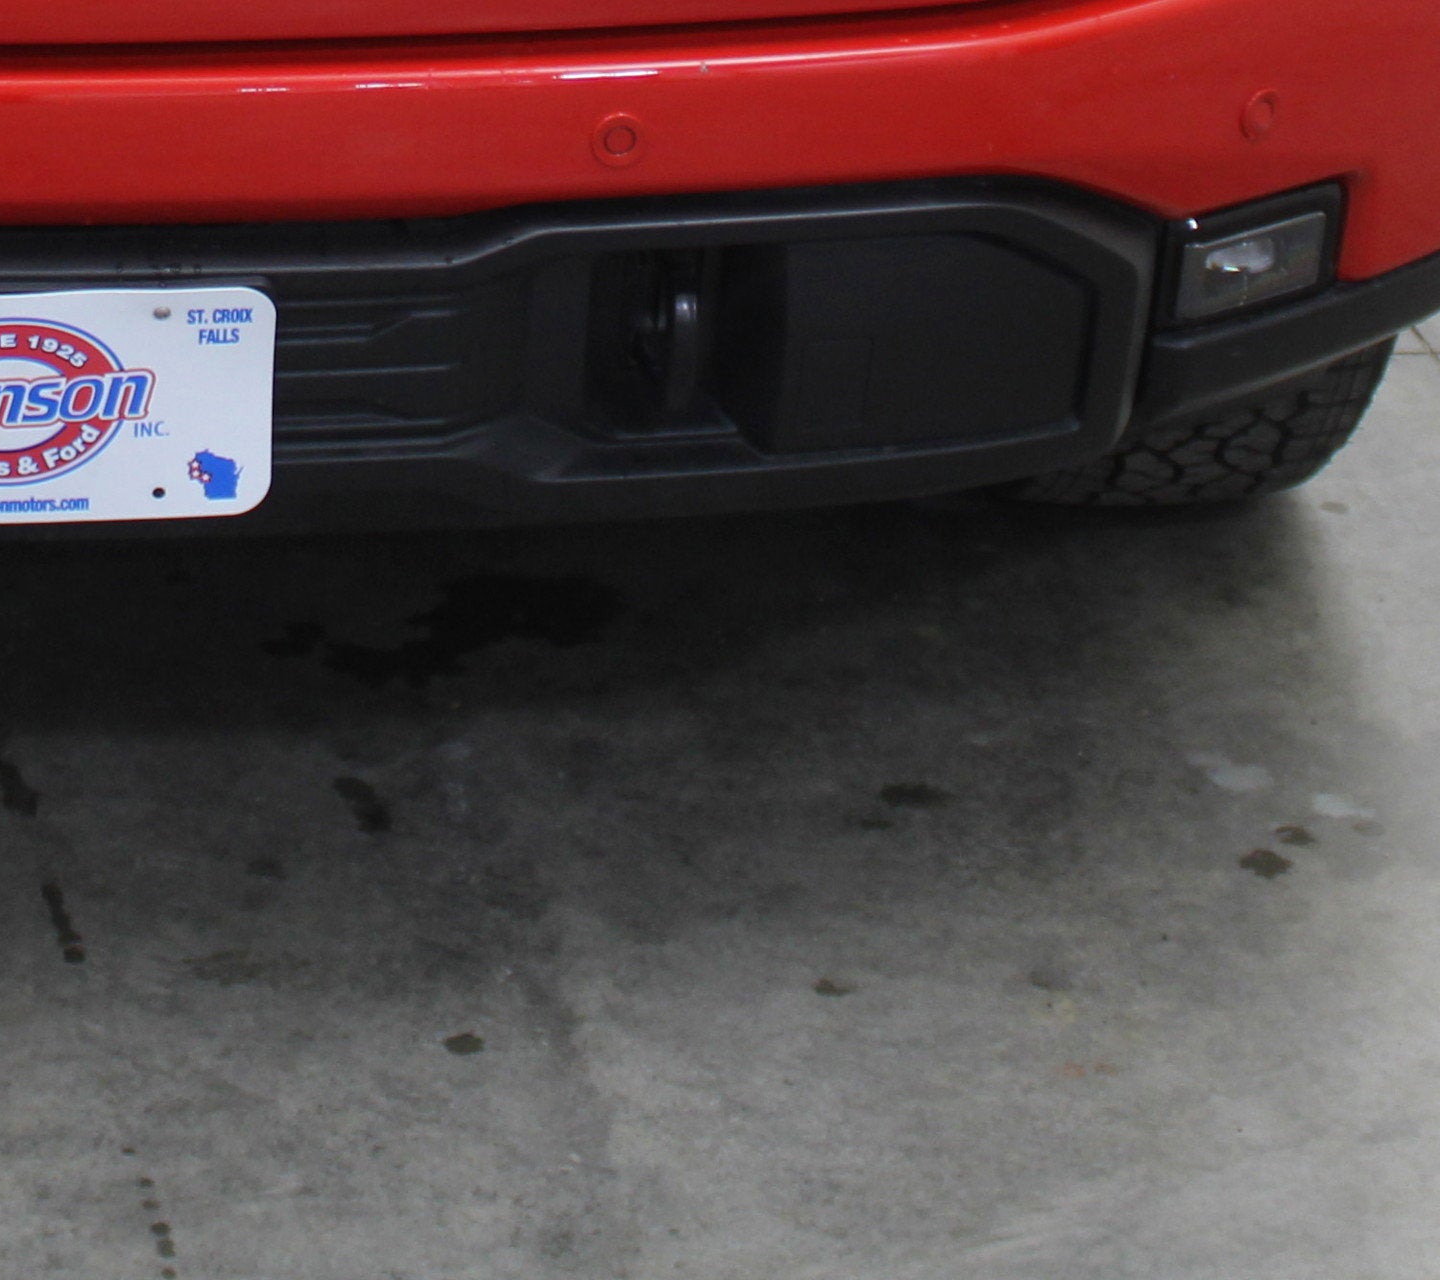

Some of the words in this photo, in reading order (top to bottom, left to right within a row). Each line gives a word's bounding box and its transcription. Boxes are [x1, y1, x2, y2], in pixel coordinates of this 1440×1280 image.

[187, 309, 209, 324] ST.
[213, 308, 253, 324] CROIX
[198, 328, 240, 345] FALLS
[27, 335, 88, 368] 1925
[133, 421, 170, 438] INC.
[17, 456, 39, 476] &
[43, 424, 101, 468] Ford
